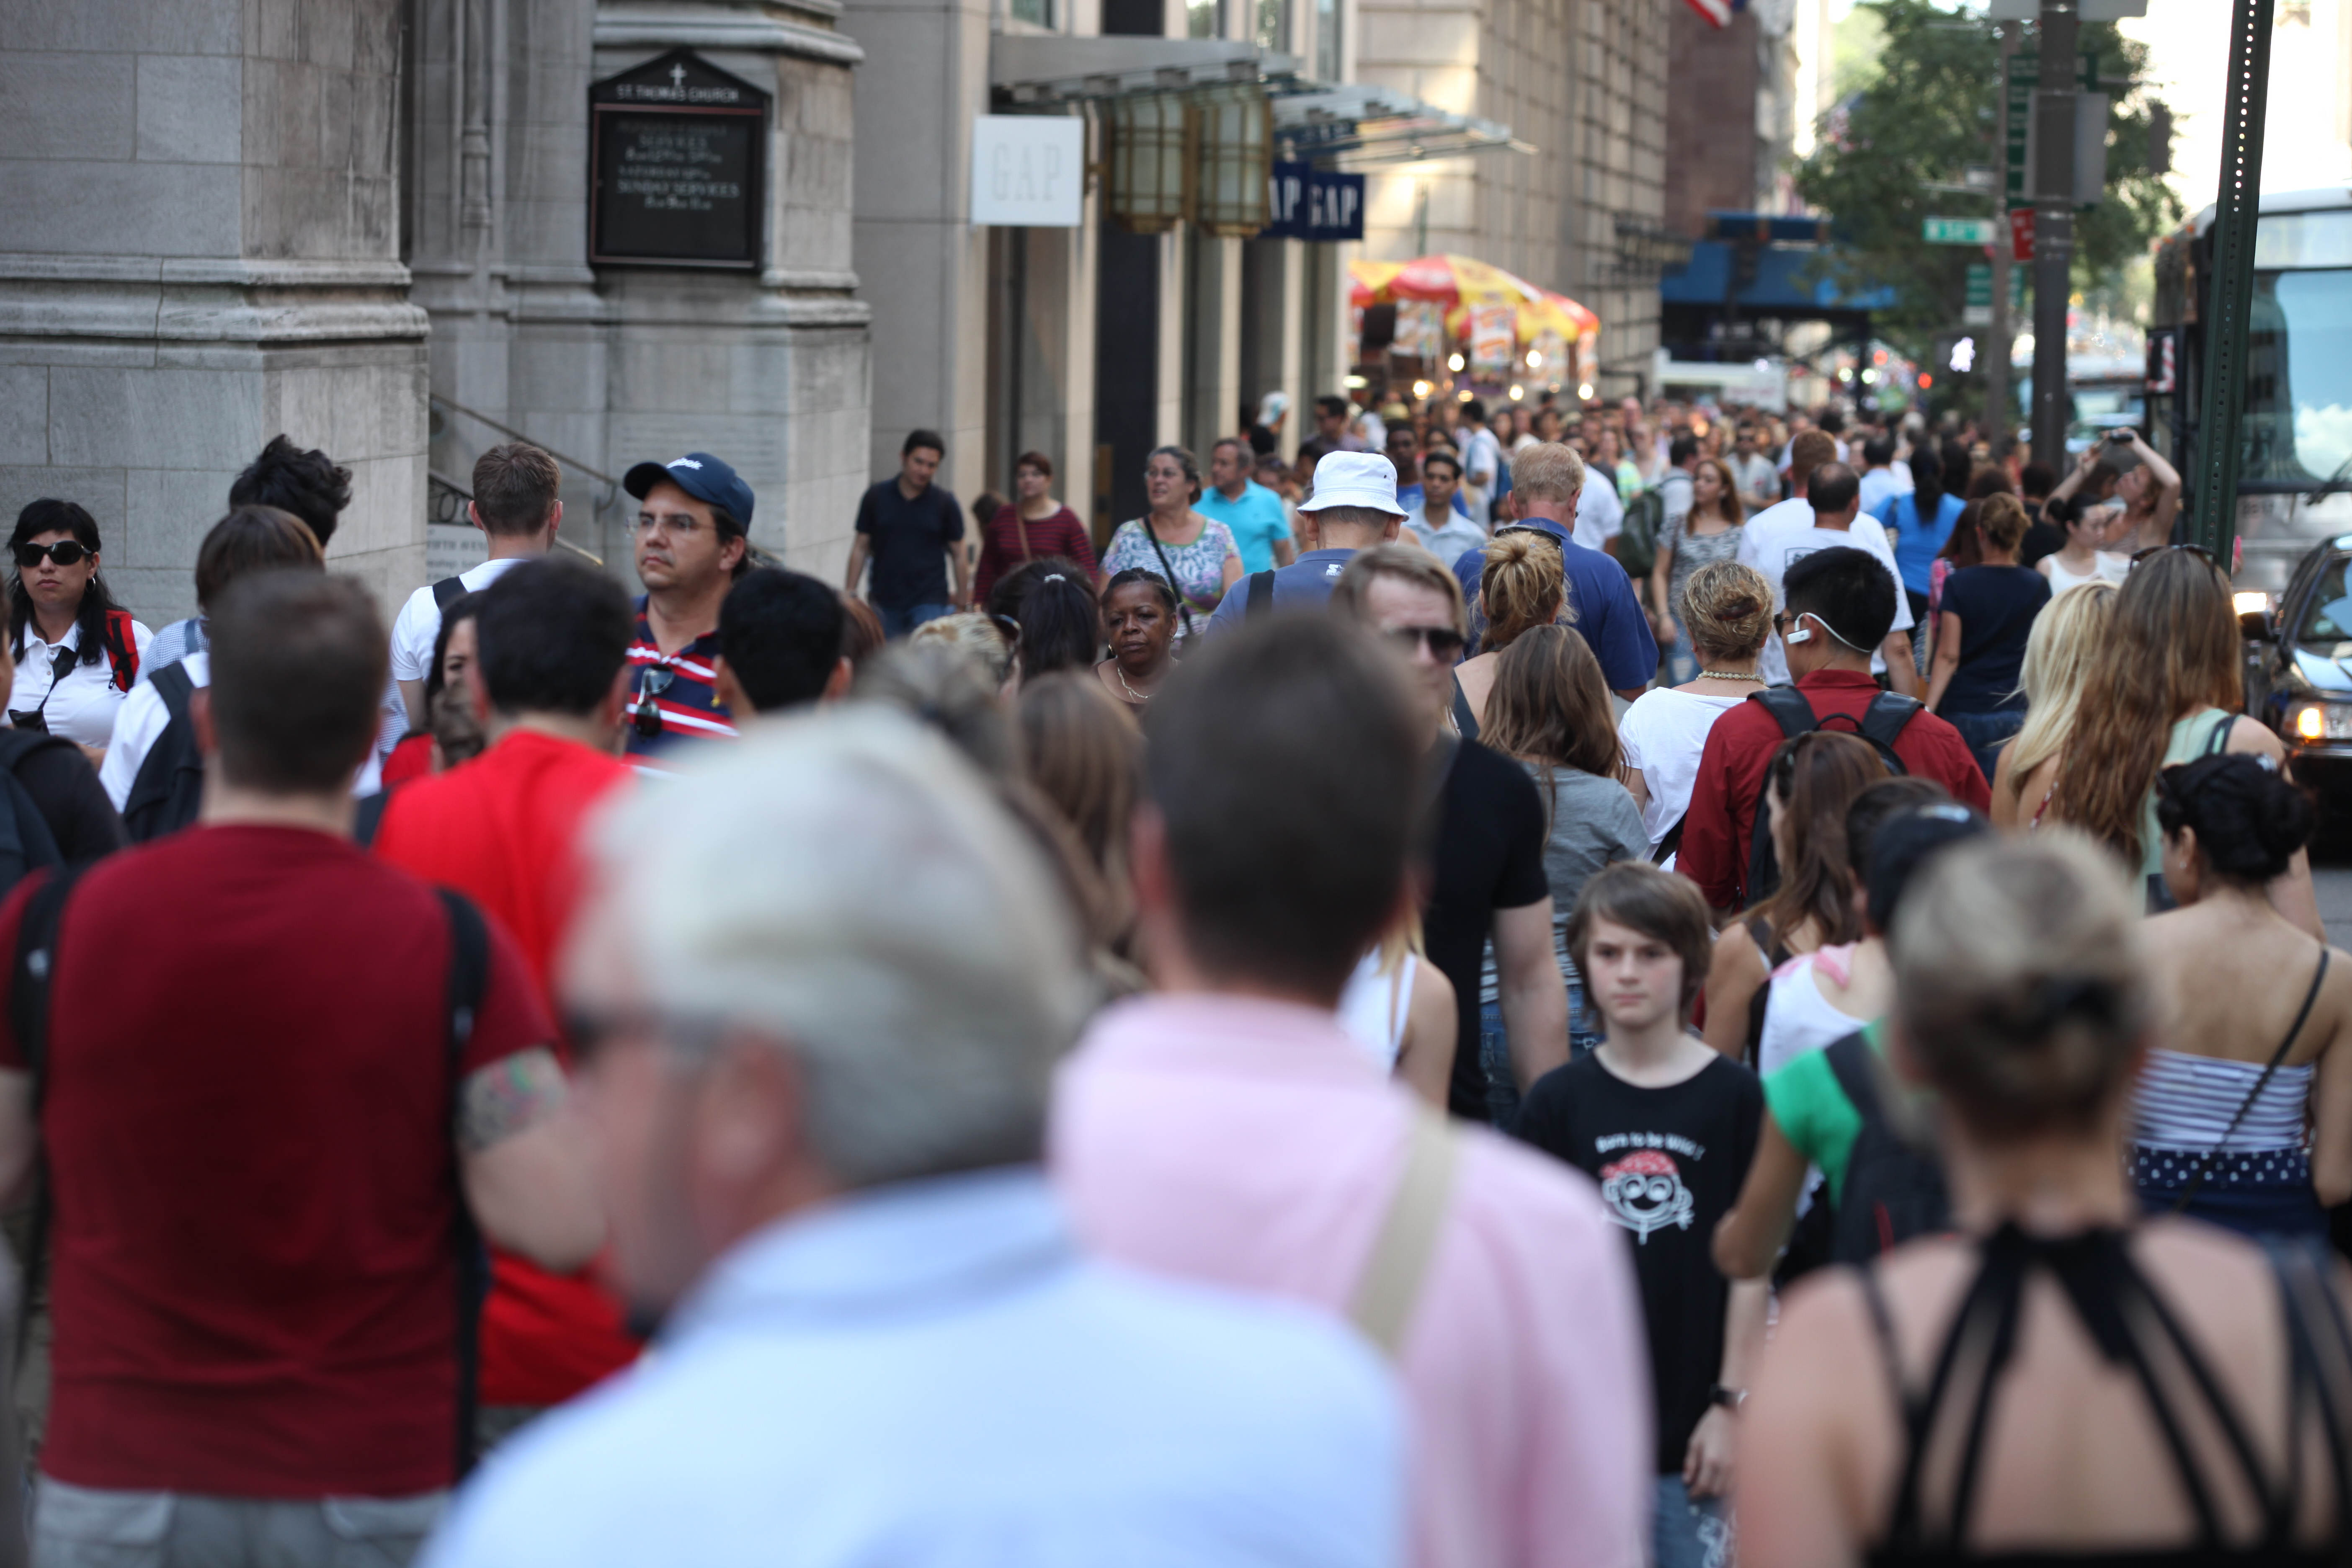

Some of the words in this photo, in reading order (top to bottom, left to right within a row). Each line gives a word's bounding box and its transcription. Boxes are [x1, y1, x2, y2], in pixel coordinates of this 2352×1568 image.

[636, 85, 686, 101] THOMAS
[689, 86, 740, 103] CHURCH
[990, 143, 1063, 201] GAP
[1268, 176, 1301, 220] AP
[1309, 185, 1358, 227] GAP
